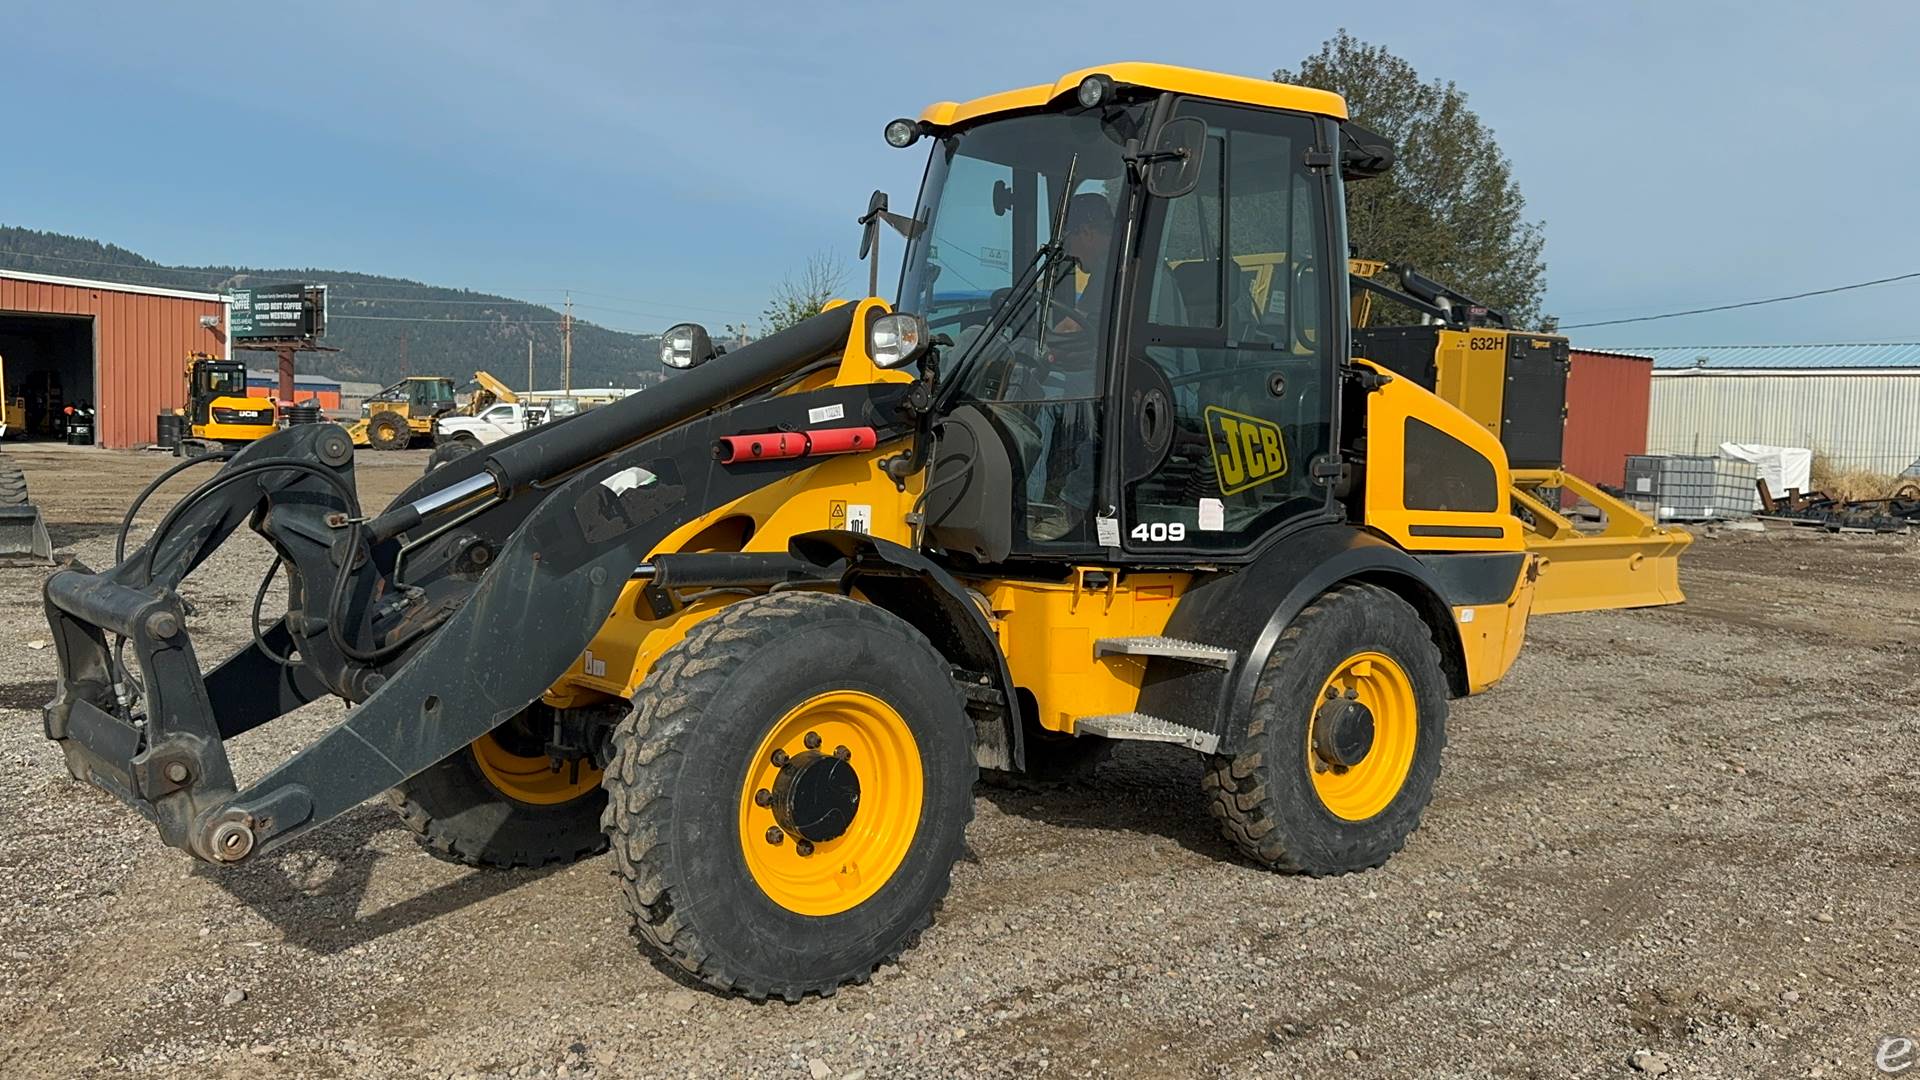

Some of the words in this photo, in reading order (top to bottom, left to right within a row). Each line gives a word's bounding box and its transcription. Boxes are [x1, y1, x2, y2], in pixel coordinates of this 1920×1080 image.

[231, 300, 250, 310] COFFEE
[283, 302, 302, 310] COFFEE
[270, 312, 293, 320] WESTERN
[1470, 338, 1504, 350] 632H
[1220, 416, 1282, 485] JCB
[1131, 523, 1185, 541] 409
